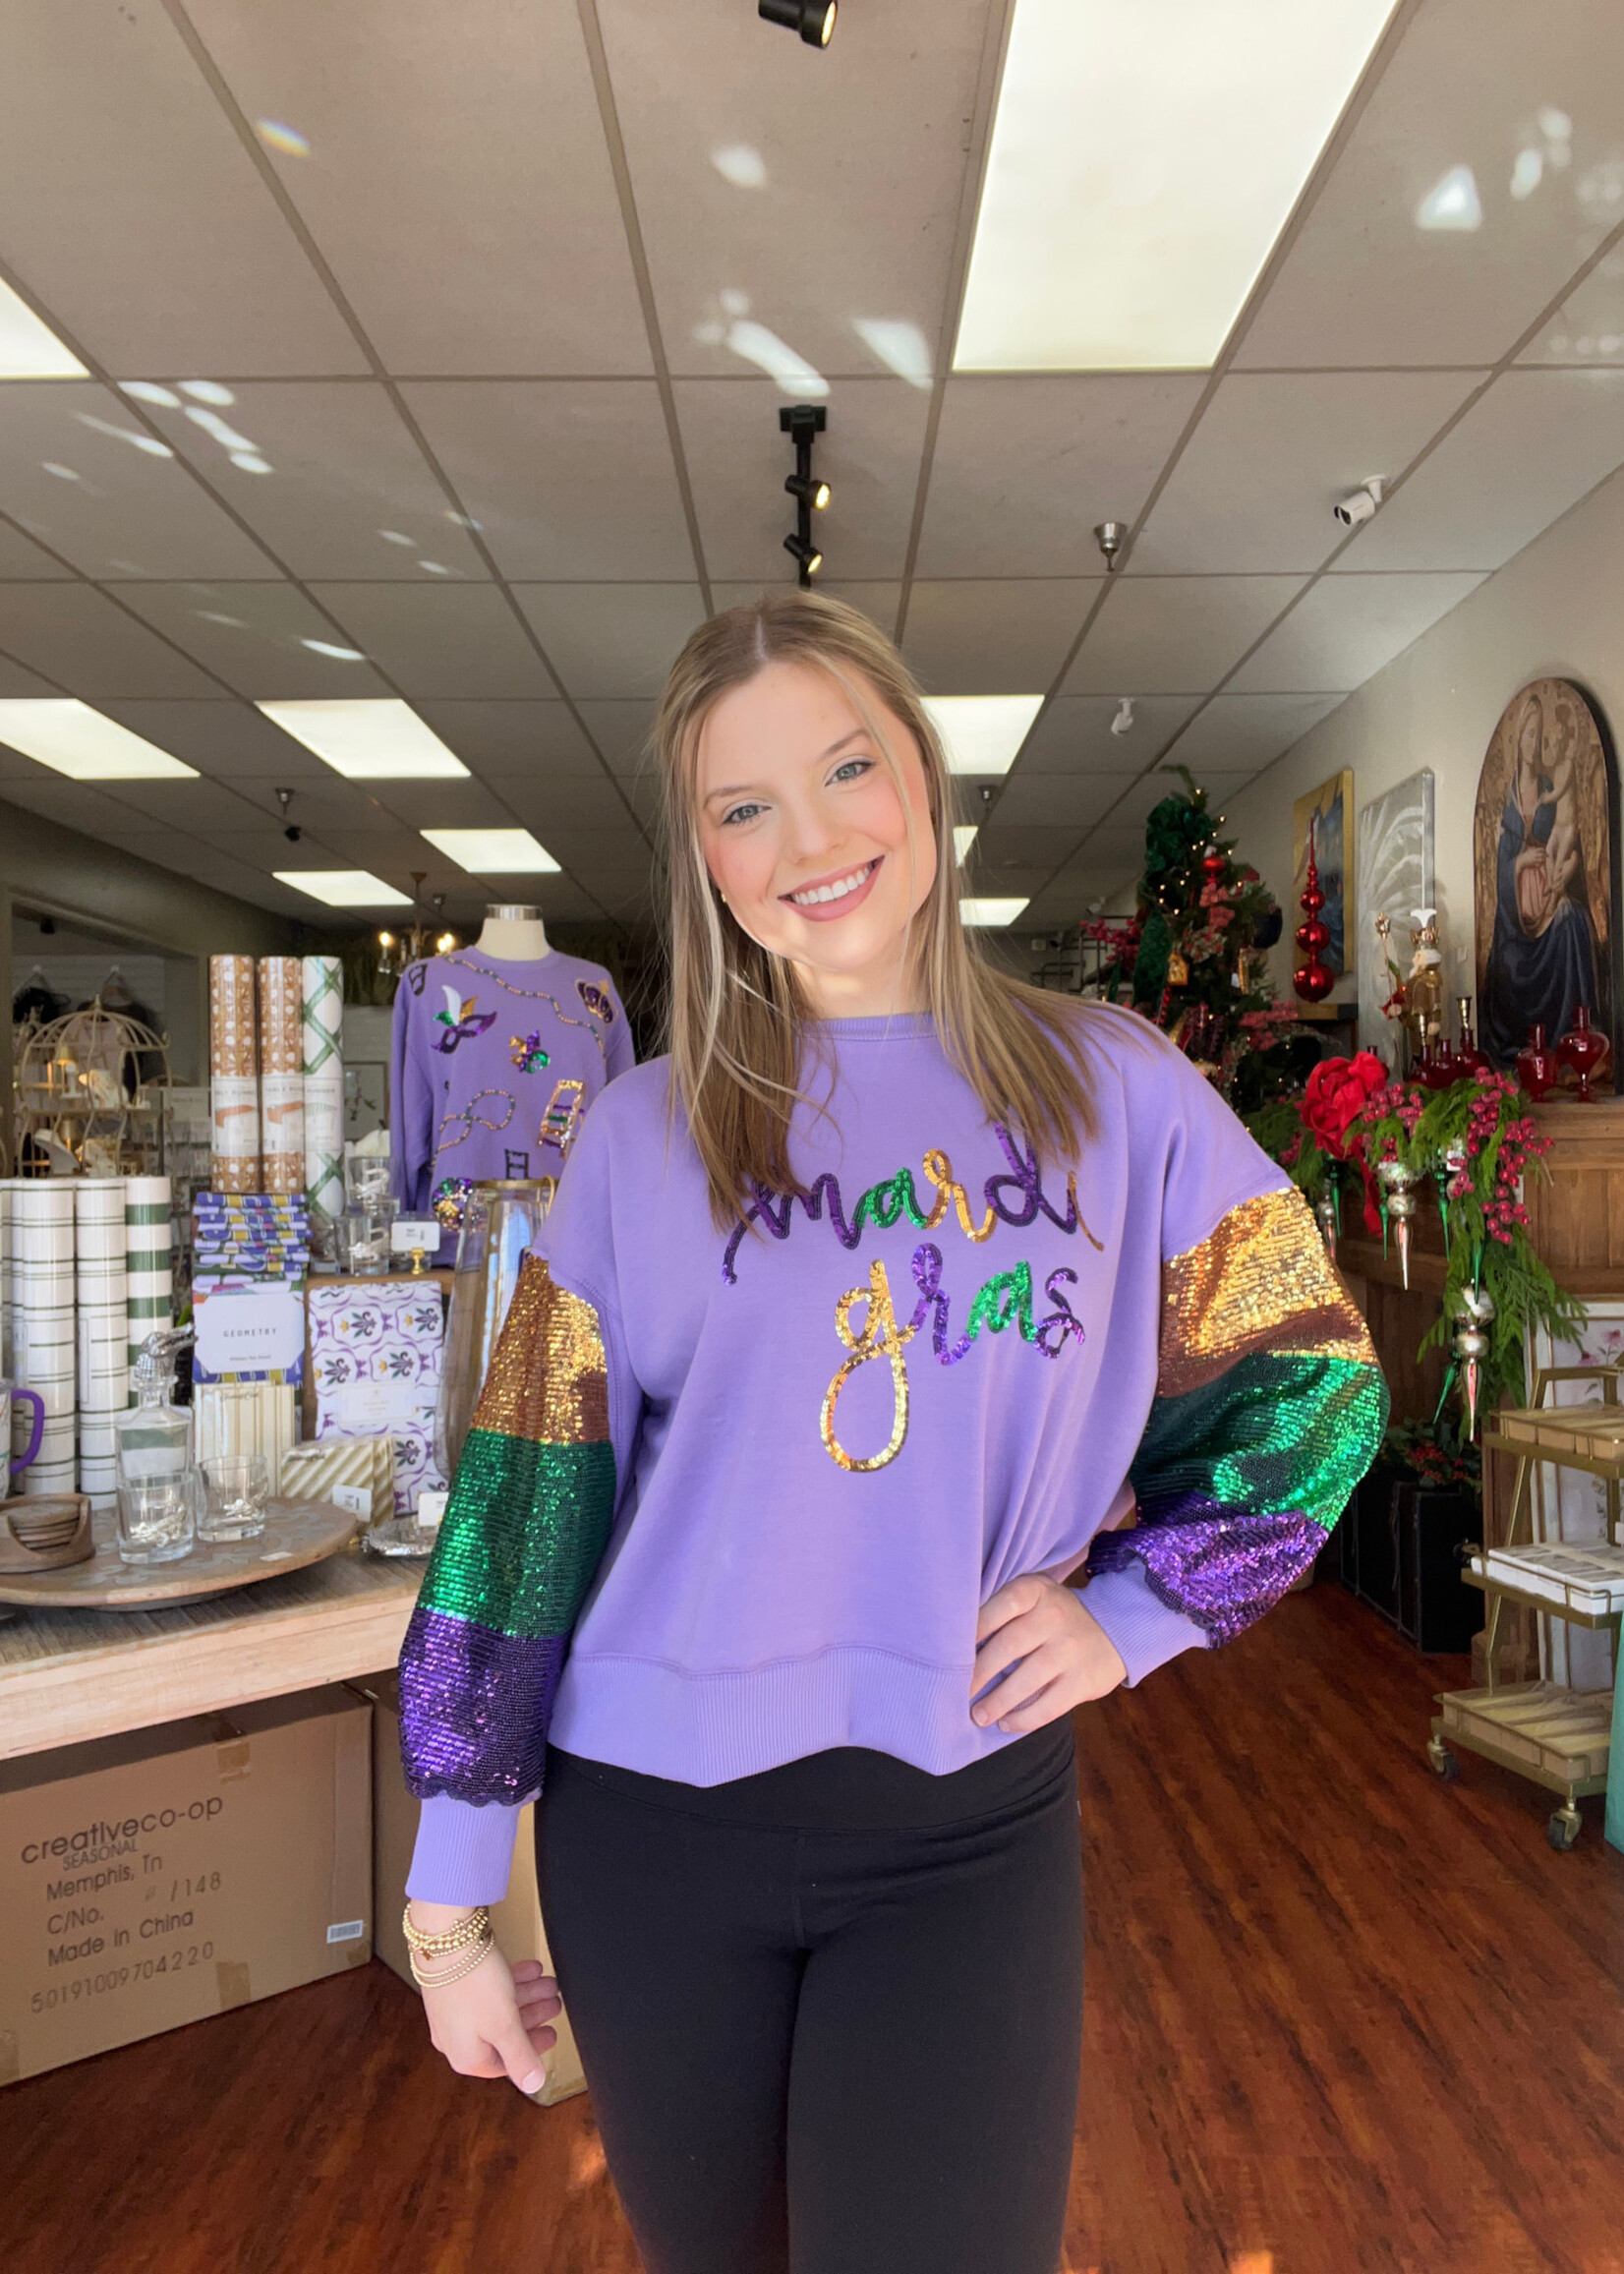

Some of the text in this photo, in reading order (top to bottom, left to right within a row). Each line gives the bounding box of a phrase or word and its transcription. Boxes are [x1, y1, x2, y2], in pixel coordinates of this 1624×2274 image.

[223, 1328, 277, 1337] GEOMETRY
[820, 1244, 1086, 1473] gras
[62, 1837, 138, 1871] SEASONAL
[46, 1863, 135, 1901] Memphis,
[143, 1853, 162, 1874] Tn
[48, 1907, 104, 1935] C/No.
[48, 1911, 195, 1966] Made in China
